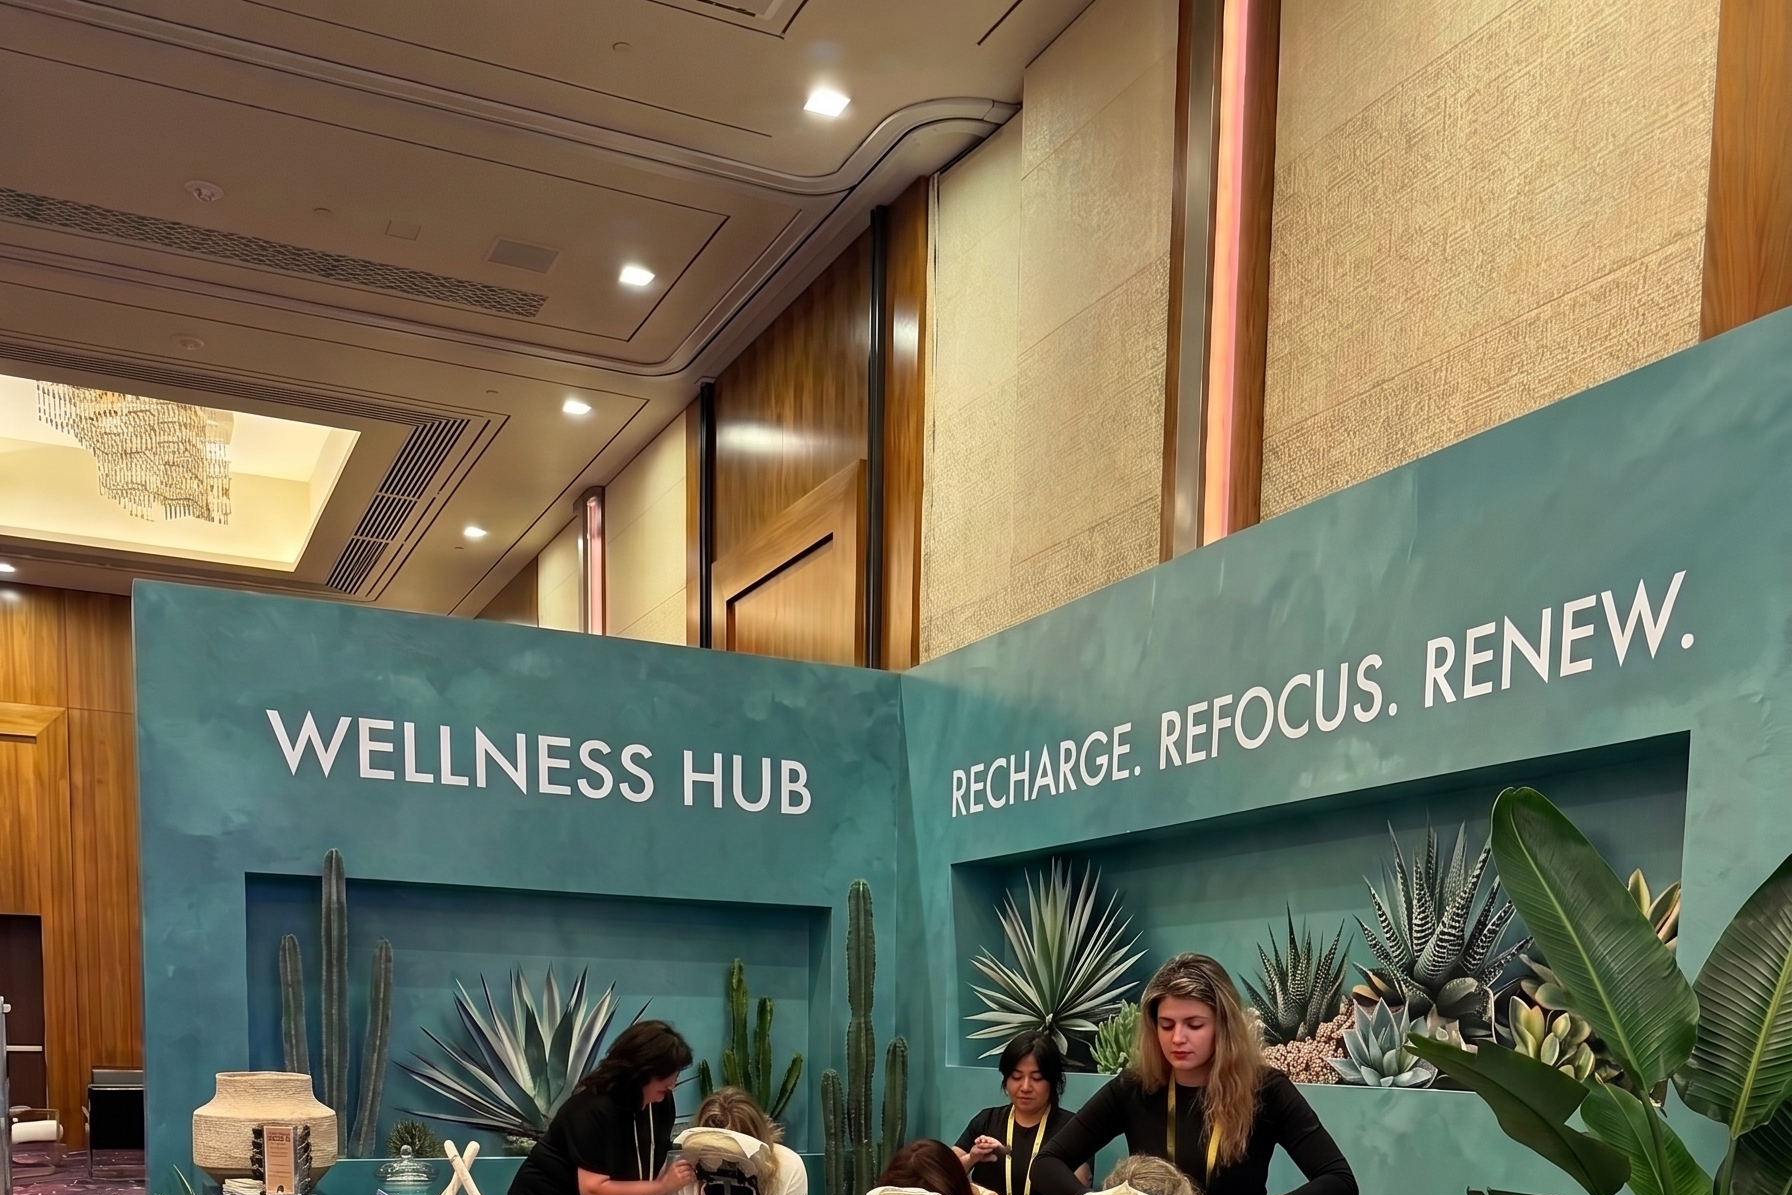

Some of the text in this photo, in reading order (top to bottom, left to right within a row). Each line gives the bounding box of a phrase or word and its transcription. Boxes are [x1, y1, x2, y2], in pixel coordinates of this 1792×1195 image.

[265, 708, 813, 815] WELLNESS HUB
[951, 569, 1696, 818] RECHARGE. REFOCUS. RENEW.
